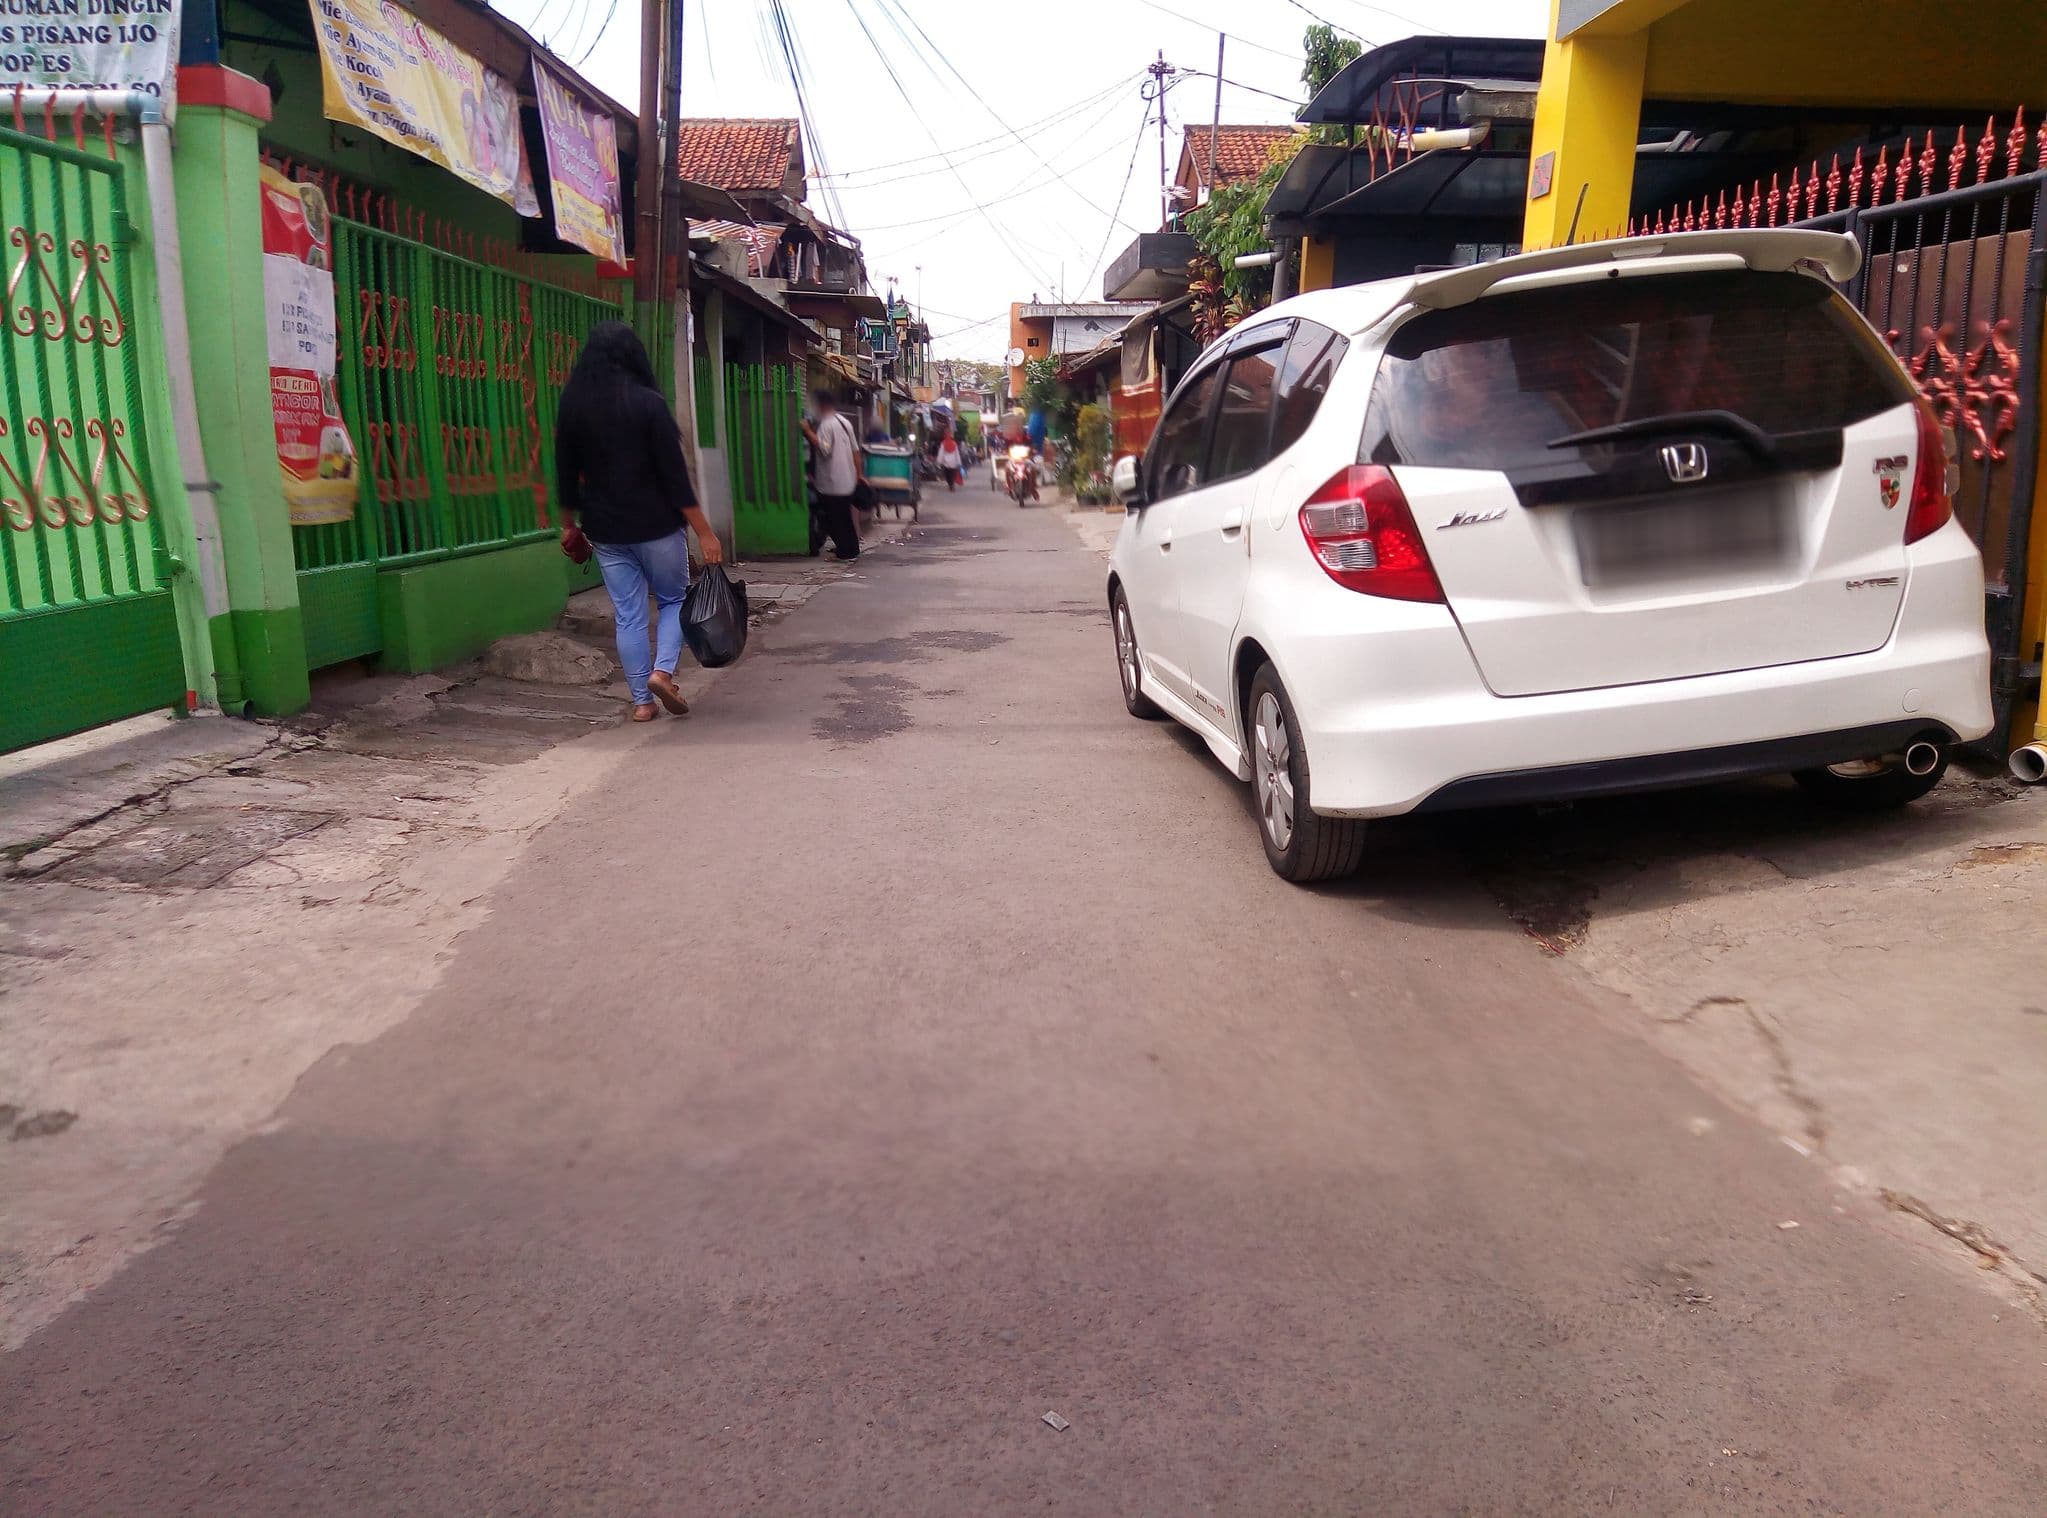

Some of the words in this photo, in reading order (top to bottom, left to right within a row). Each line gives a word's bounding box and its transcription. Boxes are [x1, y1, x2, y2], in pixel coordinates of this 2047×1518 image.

[88, 0, 172, 15] DINGIN
[0, 26, 15, 43] S
[20, 25, 112, 44] PISANG
[119, 25, 157, 43] IJO
[43, 54, 71, 72] ES
